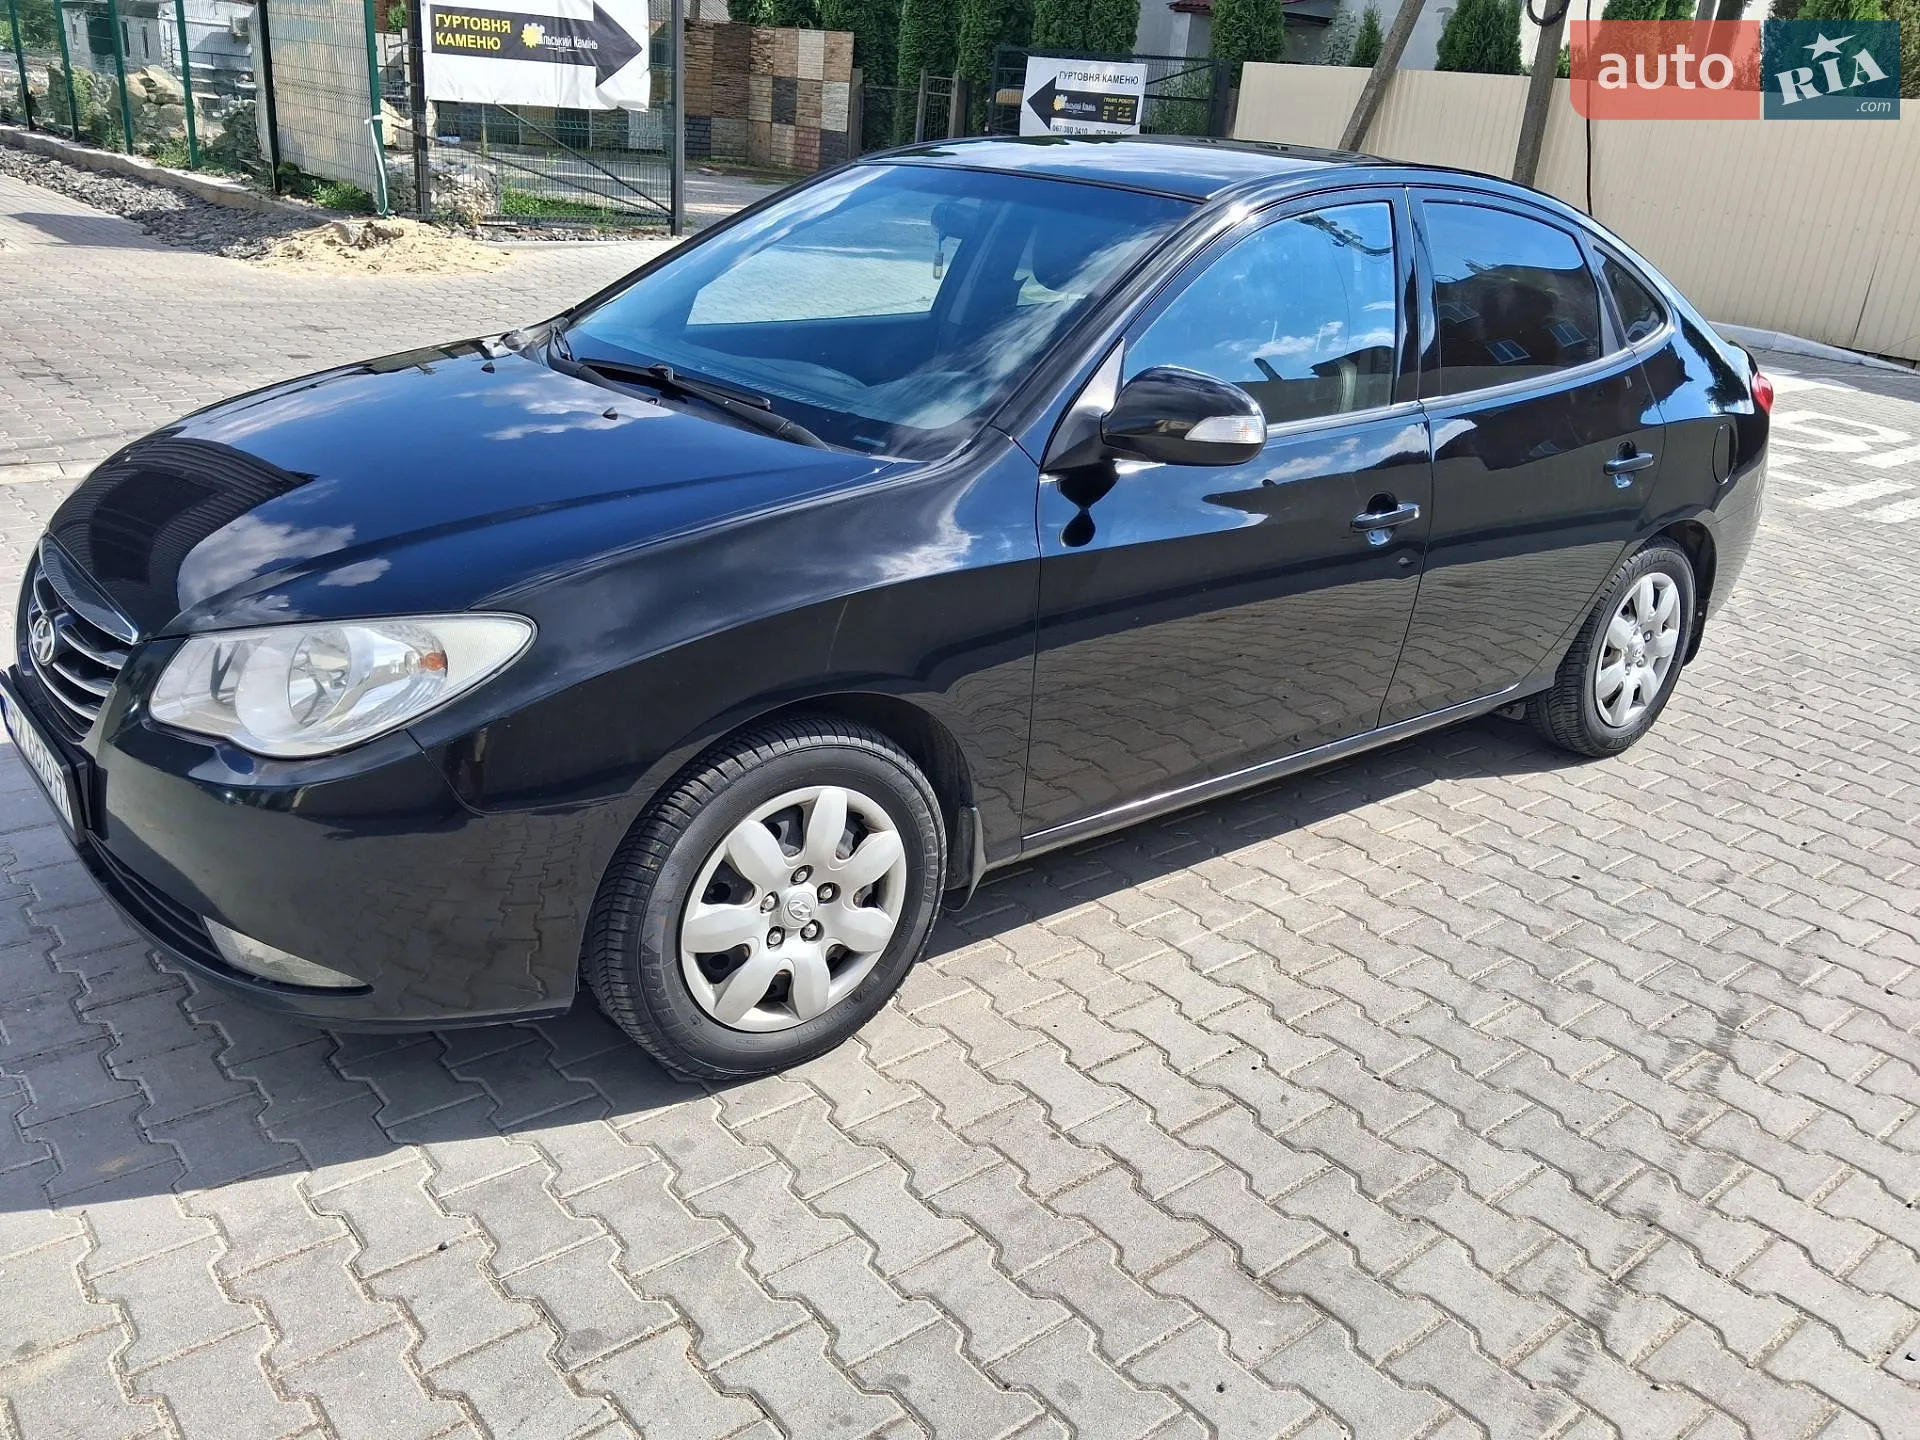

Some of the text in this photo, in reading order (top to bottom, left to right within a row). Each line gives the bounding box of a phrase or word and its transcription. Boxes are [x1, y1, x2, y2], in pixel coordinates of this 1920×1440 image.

[435, 13, 512, 34] ГУРТОВНЯ
[435, 31, 502, 51] КАМЕНЮ
[573, 36, 598, 50] Камінь
[1059, 71, 1139, 85] ГУРТОВНЯ КАМЕНЮ
